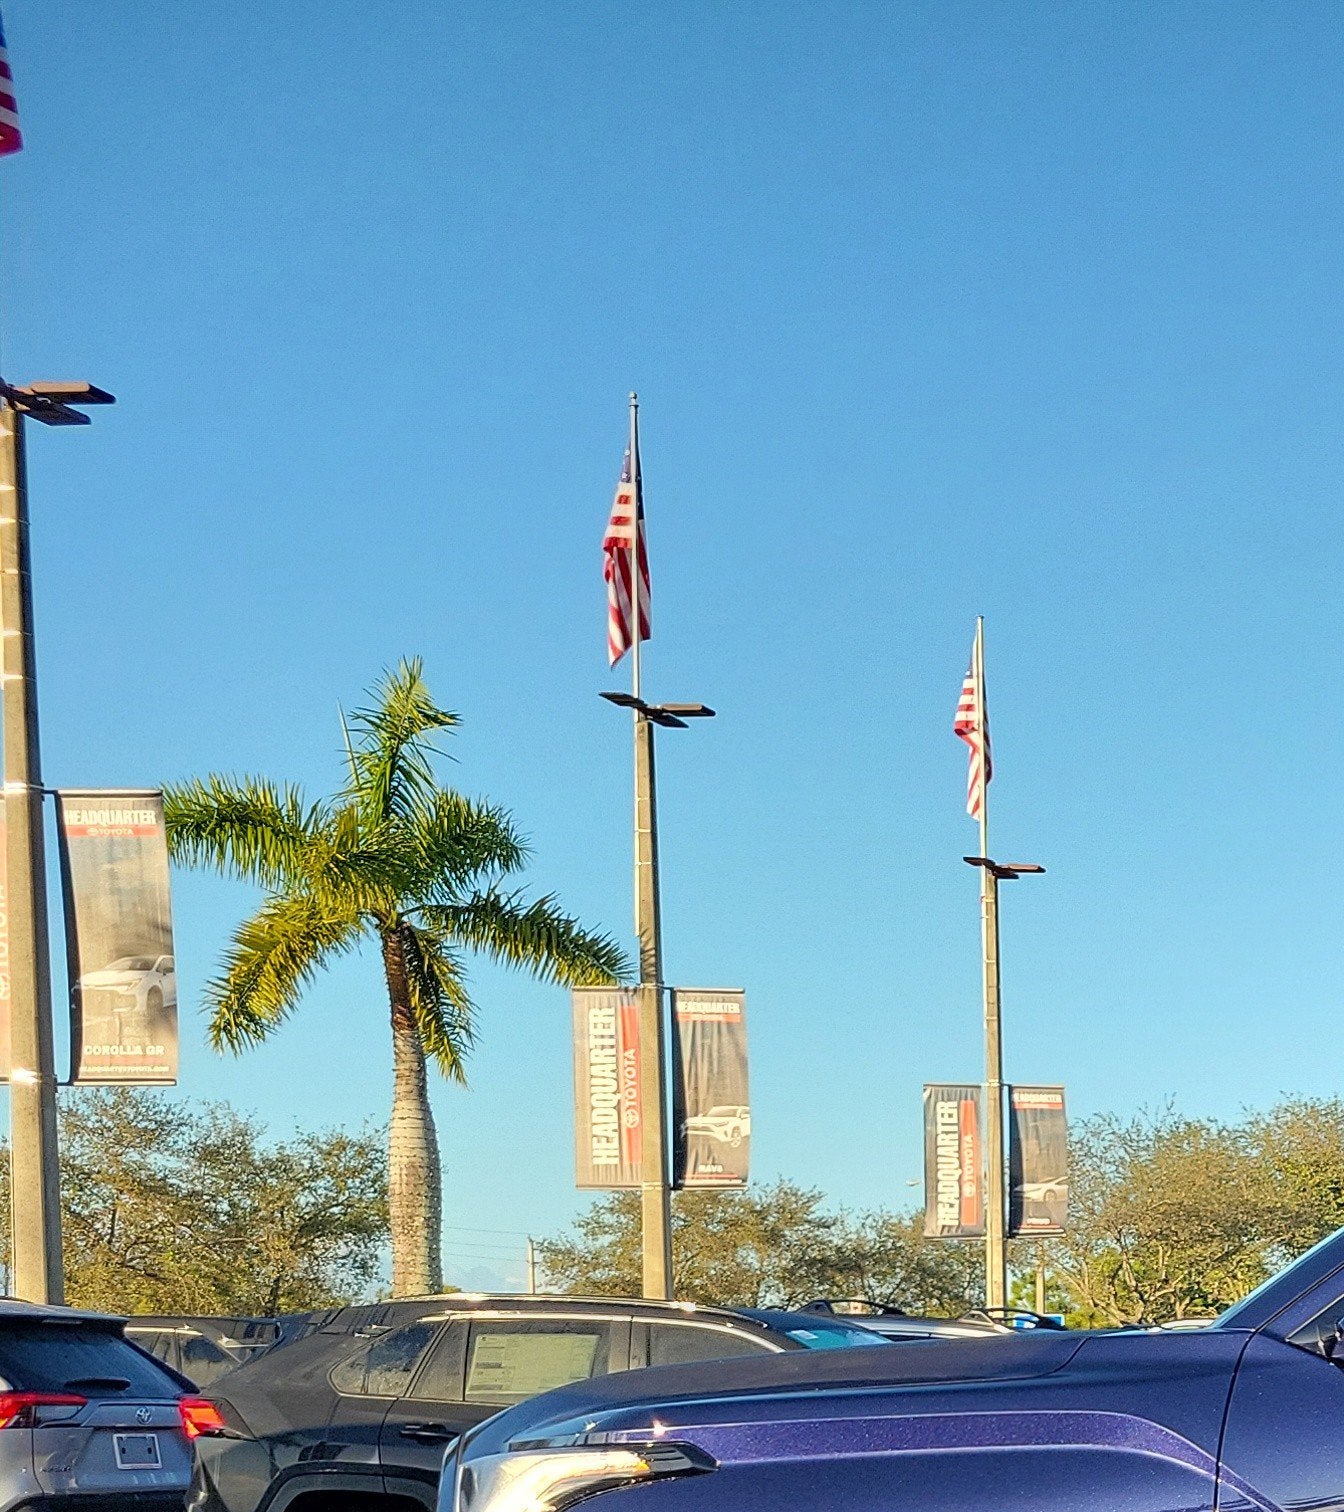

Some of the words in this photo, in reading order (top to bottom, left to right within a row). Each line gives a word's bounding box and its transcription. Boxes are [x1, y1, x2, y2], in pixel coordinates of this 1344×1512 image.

[64, 809, 157, 827] HEADQUARTER
[99, 828, 133, 836] TOYOTA
[84, 1045, 144, 1057] COROLLA
[145, 1045, 165, 1057] GR
[588, 1007, 622, 1165] HEADQUARTER
[623, 1048, 638, 1106] TOYOTA
[936, 1101, 962, 1226] HEADQUARTER
